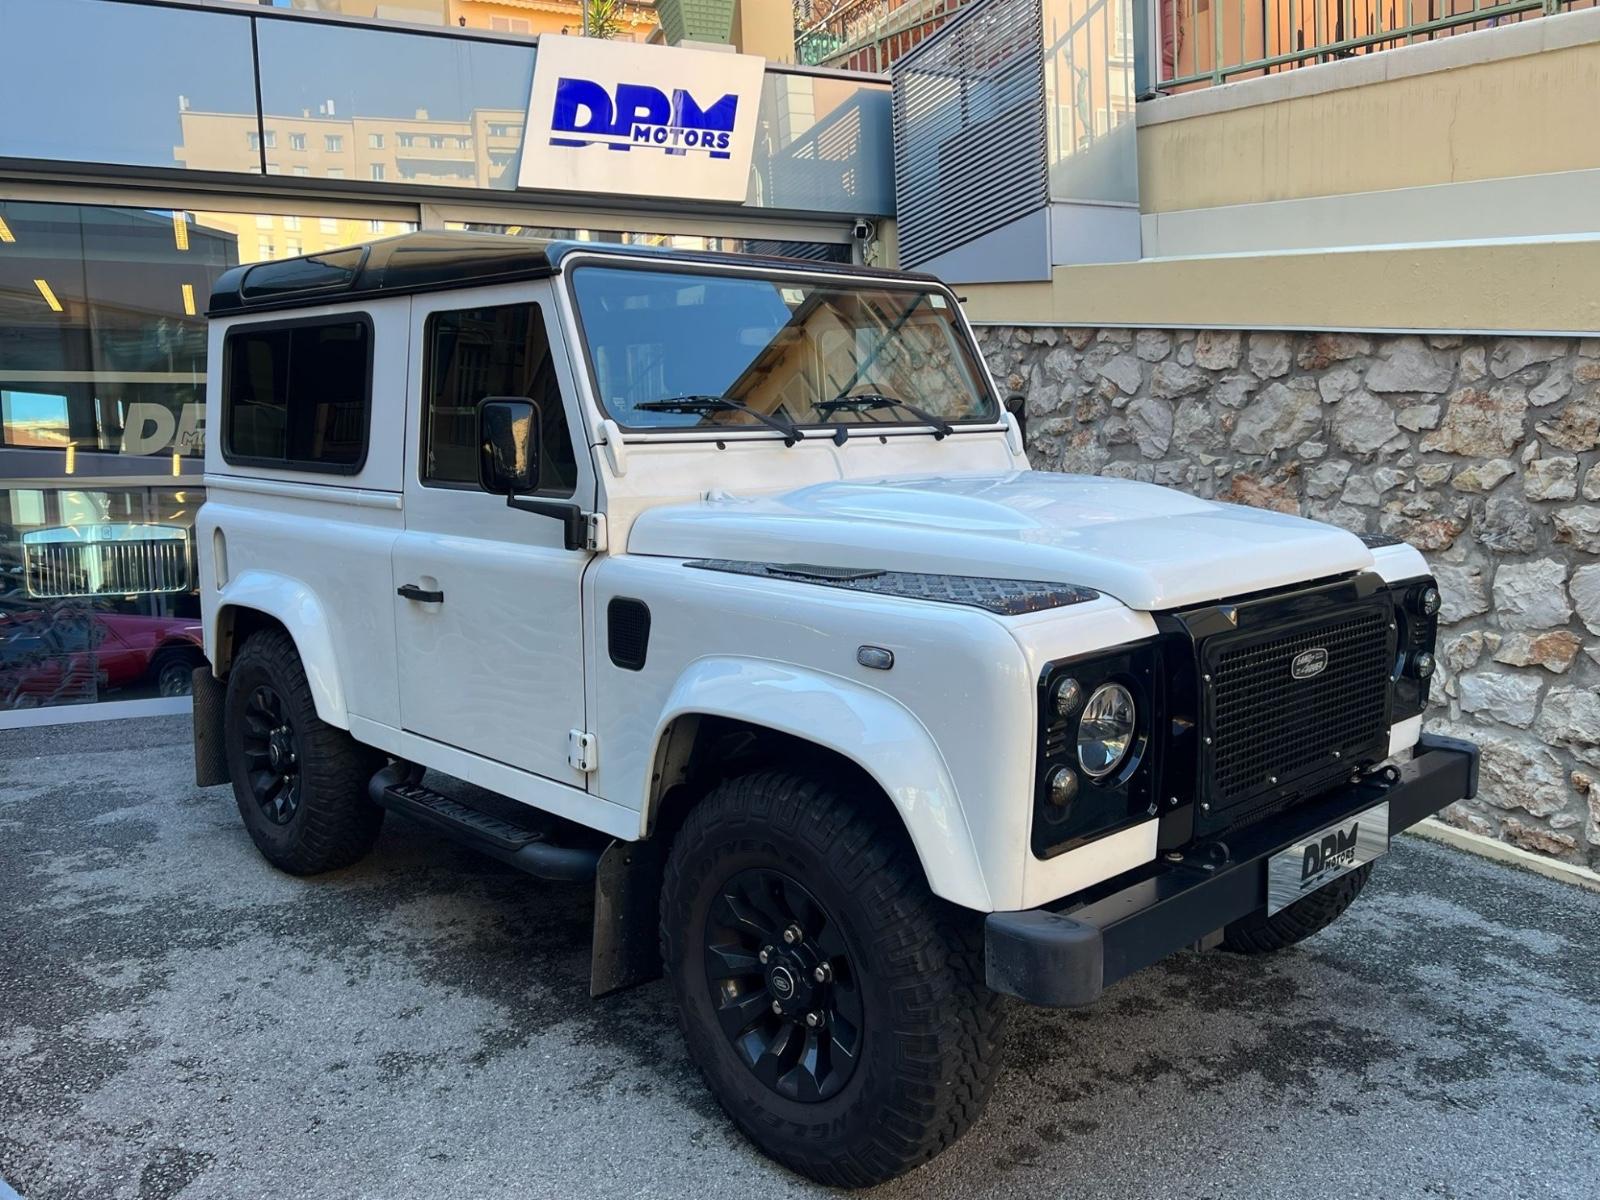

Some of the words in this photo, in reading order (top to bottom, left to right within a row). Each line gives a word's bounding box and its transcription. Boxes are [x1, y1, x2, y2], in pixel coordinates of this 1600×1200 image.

[549, 77, 739, 160] DPM
[633, 125, 731, 149] MOTORS
[1300, 822, 1359, 889] DPM
[1325, 847, 1356, 871] MOTORS
